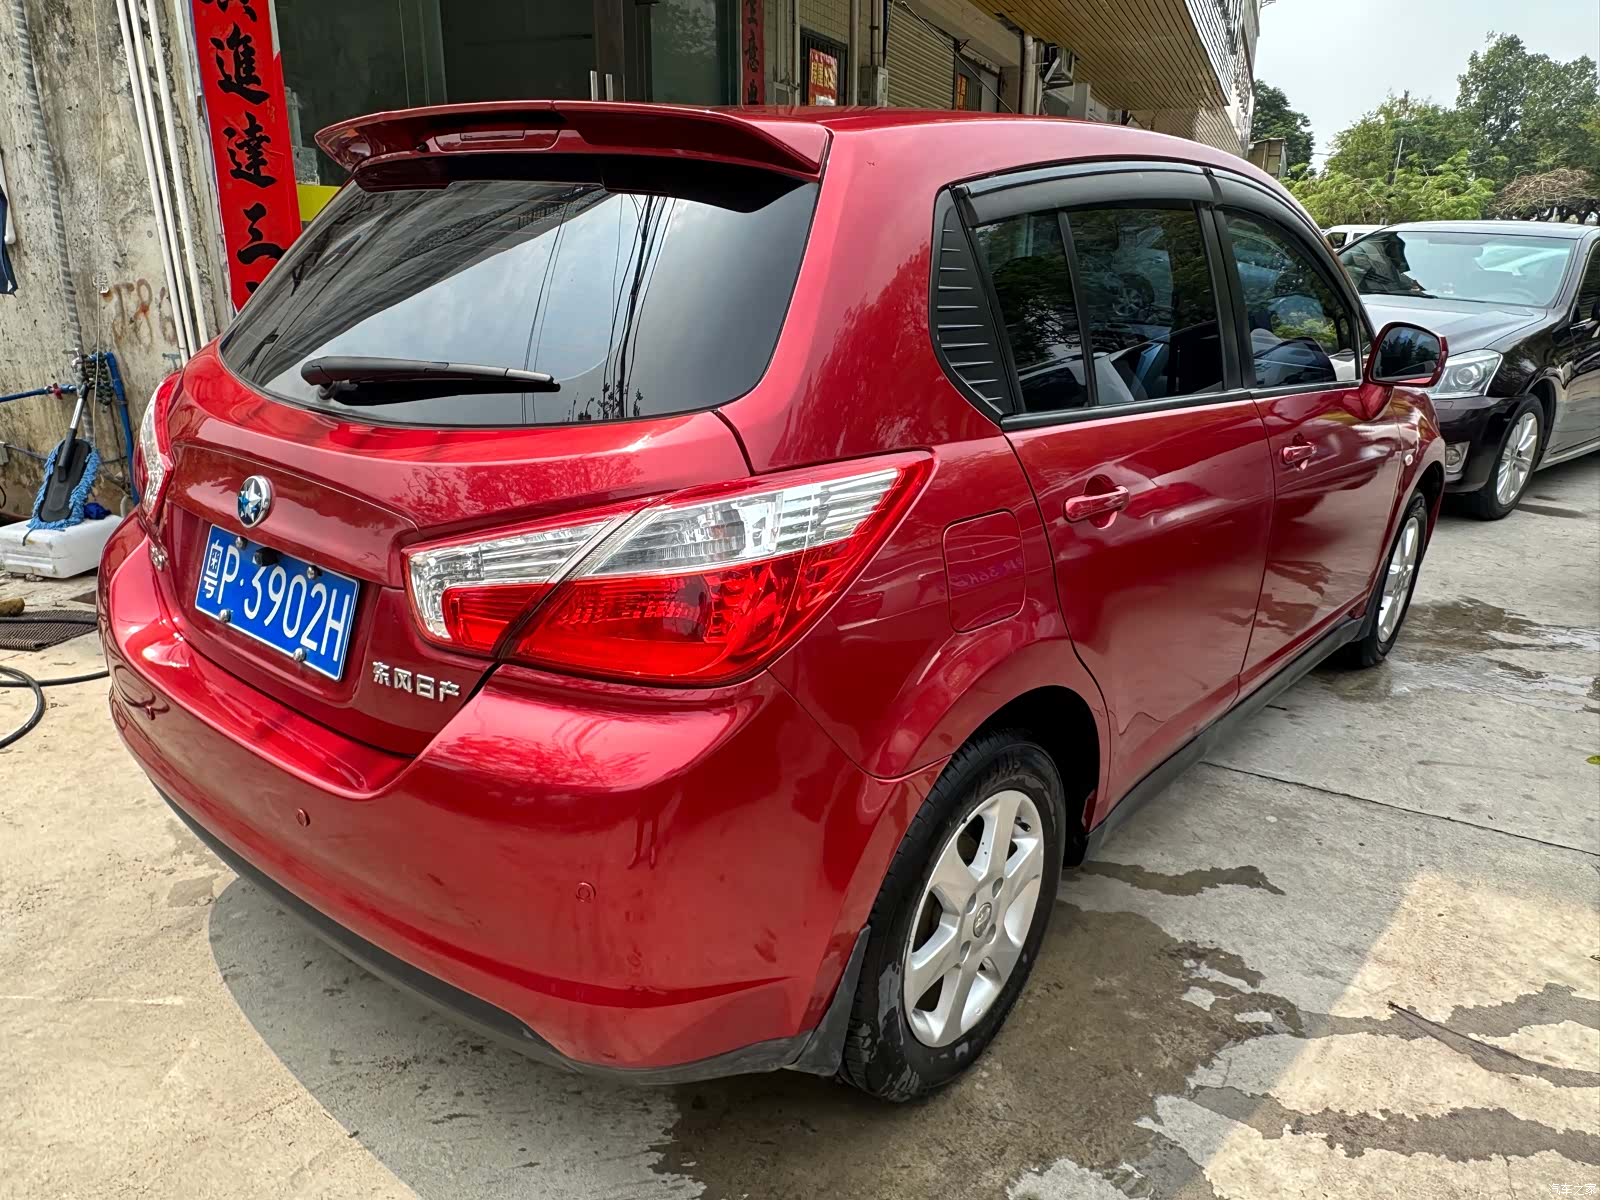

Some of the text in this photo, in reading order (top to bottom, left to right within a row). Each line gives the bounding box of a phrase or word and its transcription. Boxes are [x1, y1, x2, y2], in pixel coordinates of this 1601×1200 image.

[202, 0, 288, 294] 進達三
[372, 661, 460, 702] 东风日产
